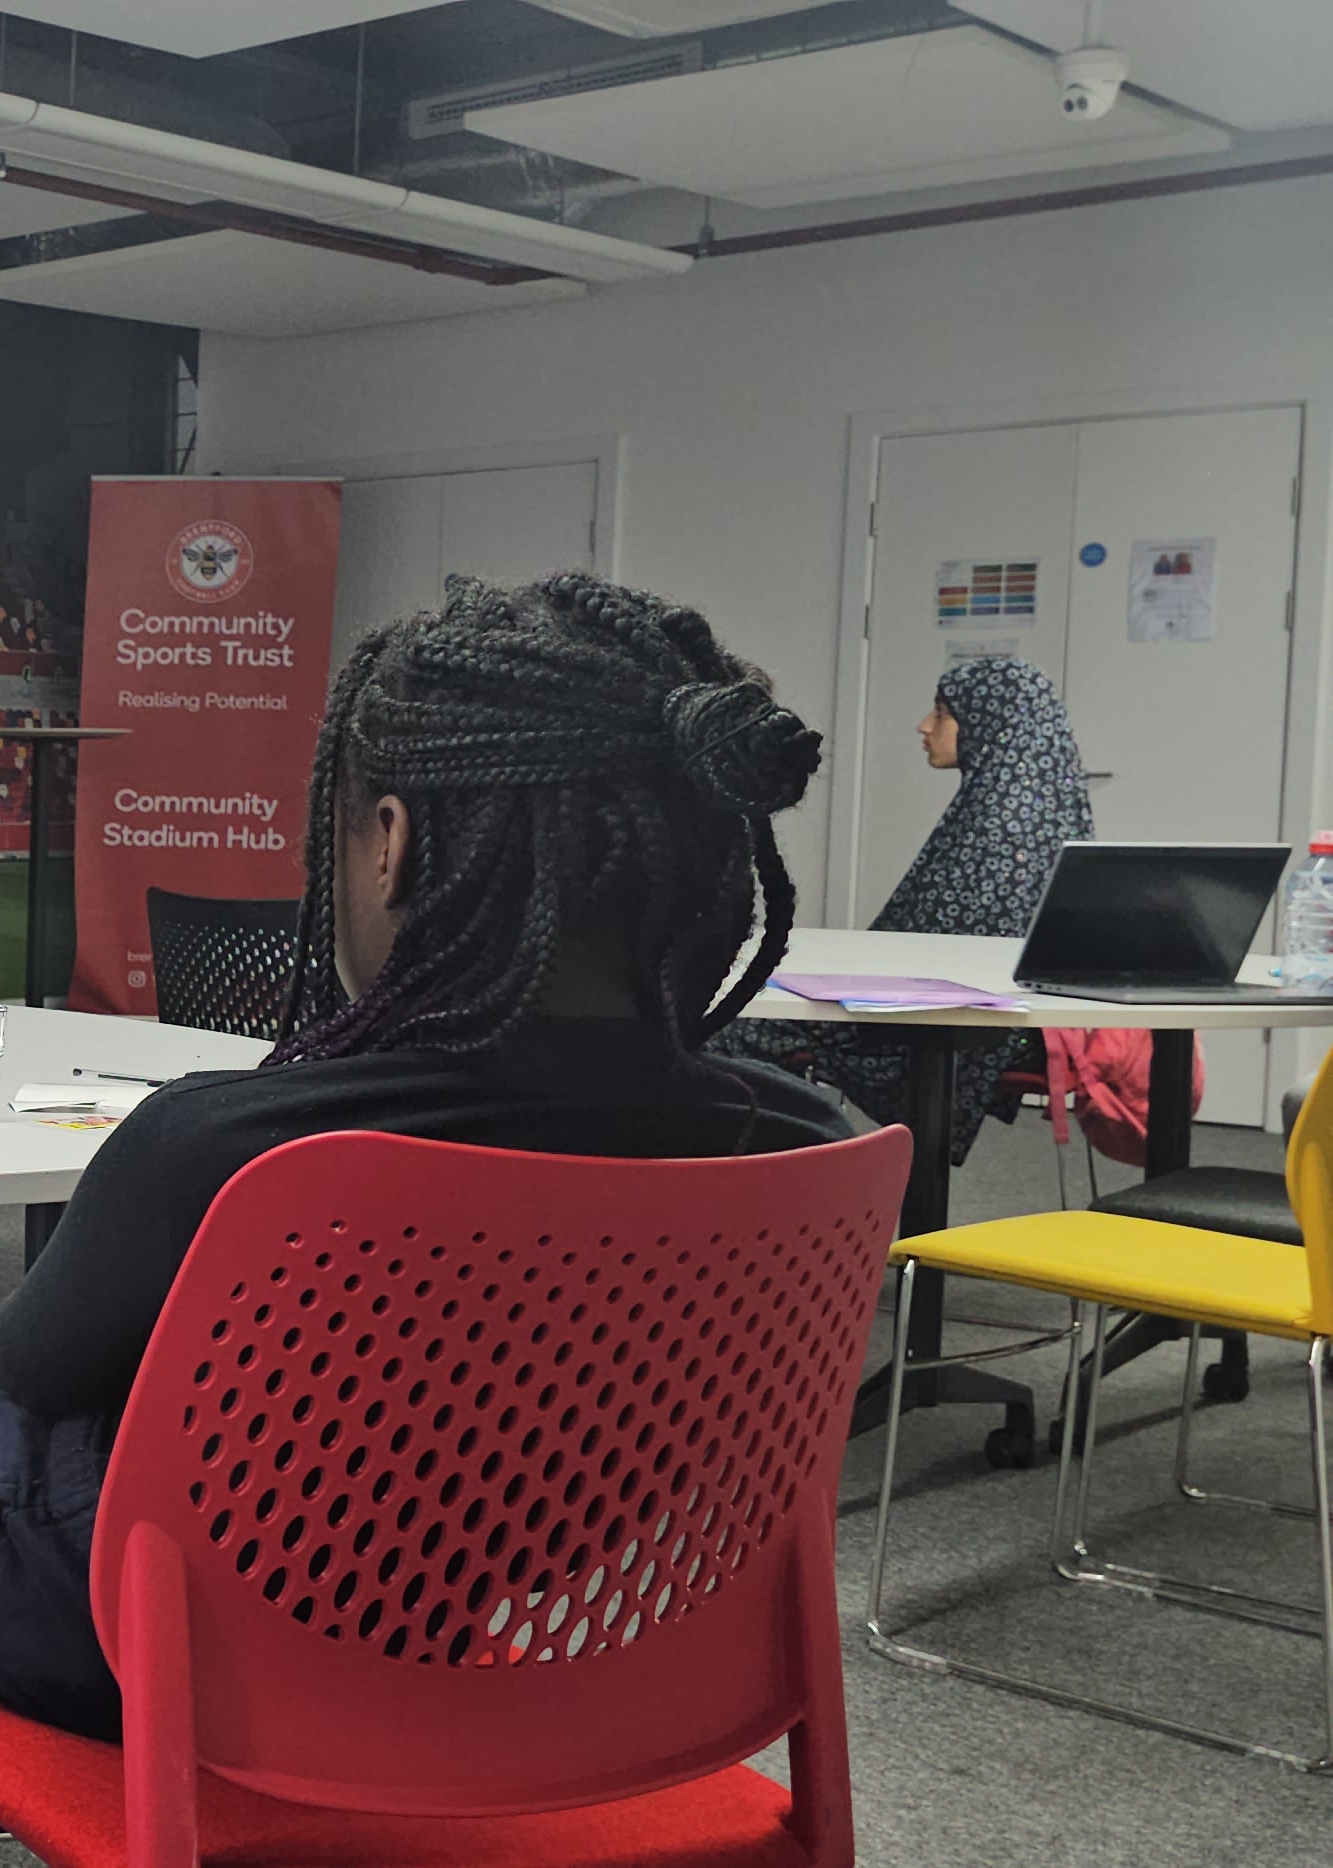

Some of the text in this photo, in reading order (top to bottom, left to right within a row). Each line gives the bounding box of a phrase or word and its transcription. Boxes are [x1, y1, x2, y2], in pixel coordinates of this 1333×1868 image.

[119, 607, 295, 643] Community
[115, 638, 295, 671] Sports Trust
[117, 689, 289, 712] Realising Potential
[113, 787, 279, 822] Community
[102, 821, 287, 851] Stadium Hub
